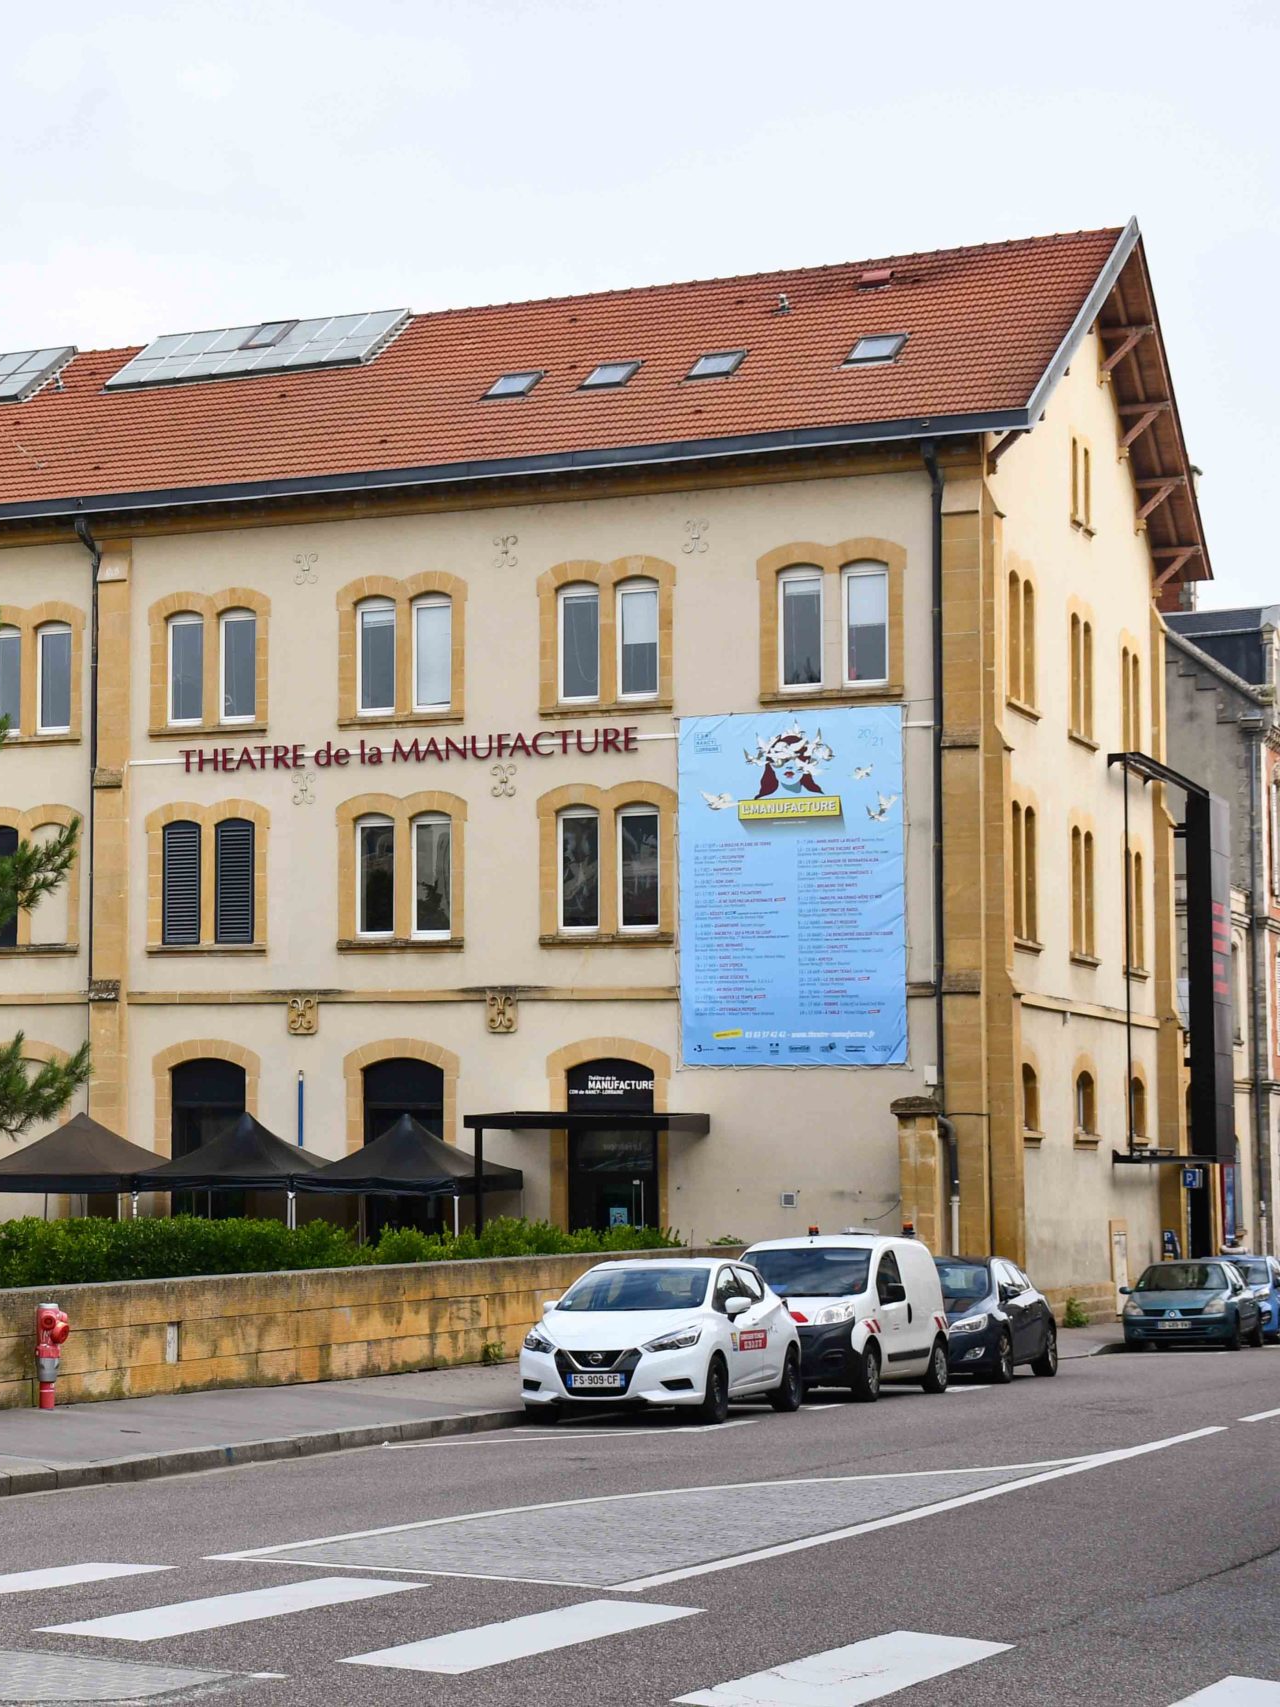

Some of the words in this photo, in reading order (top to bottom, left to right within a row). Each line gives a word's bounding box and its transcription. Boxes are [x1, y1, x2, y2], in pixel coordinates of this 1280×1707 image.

[179, 744, 306, 773] THEATRE
[314, 741, 350, 767] de
[360, 739, 383, 764] la
[392, 727, 638, 763] MANUFACTURE
[751, 801, 836, 814] MANUFACTURE
[588, 1081, 654, 1089] MANUFACTURE
[1186, 1173, 1193, 1184] P
[1164, 1231, 1172, 1241] P
[573, 1375, 618, 1385] FS-909-CF
